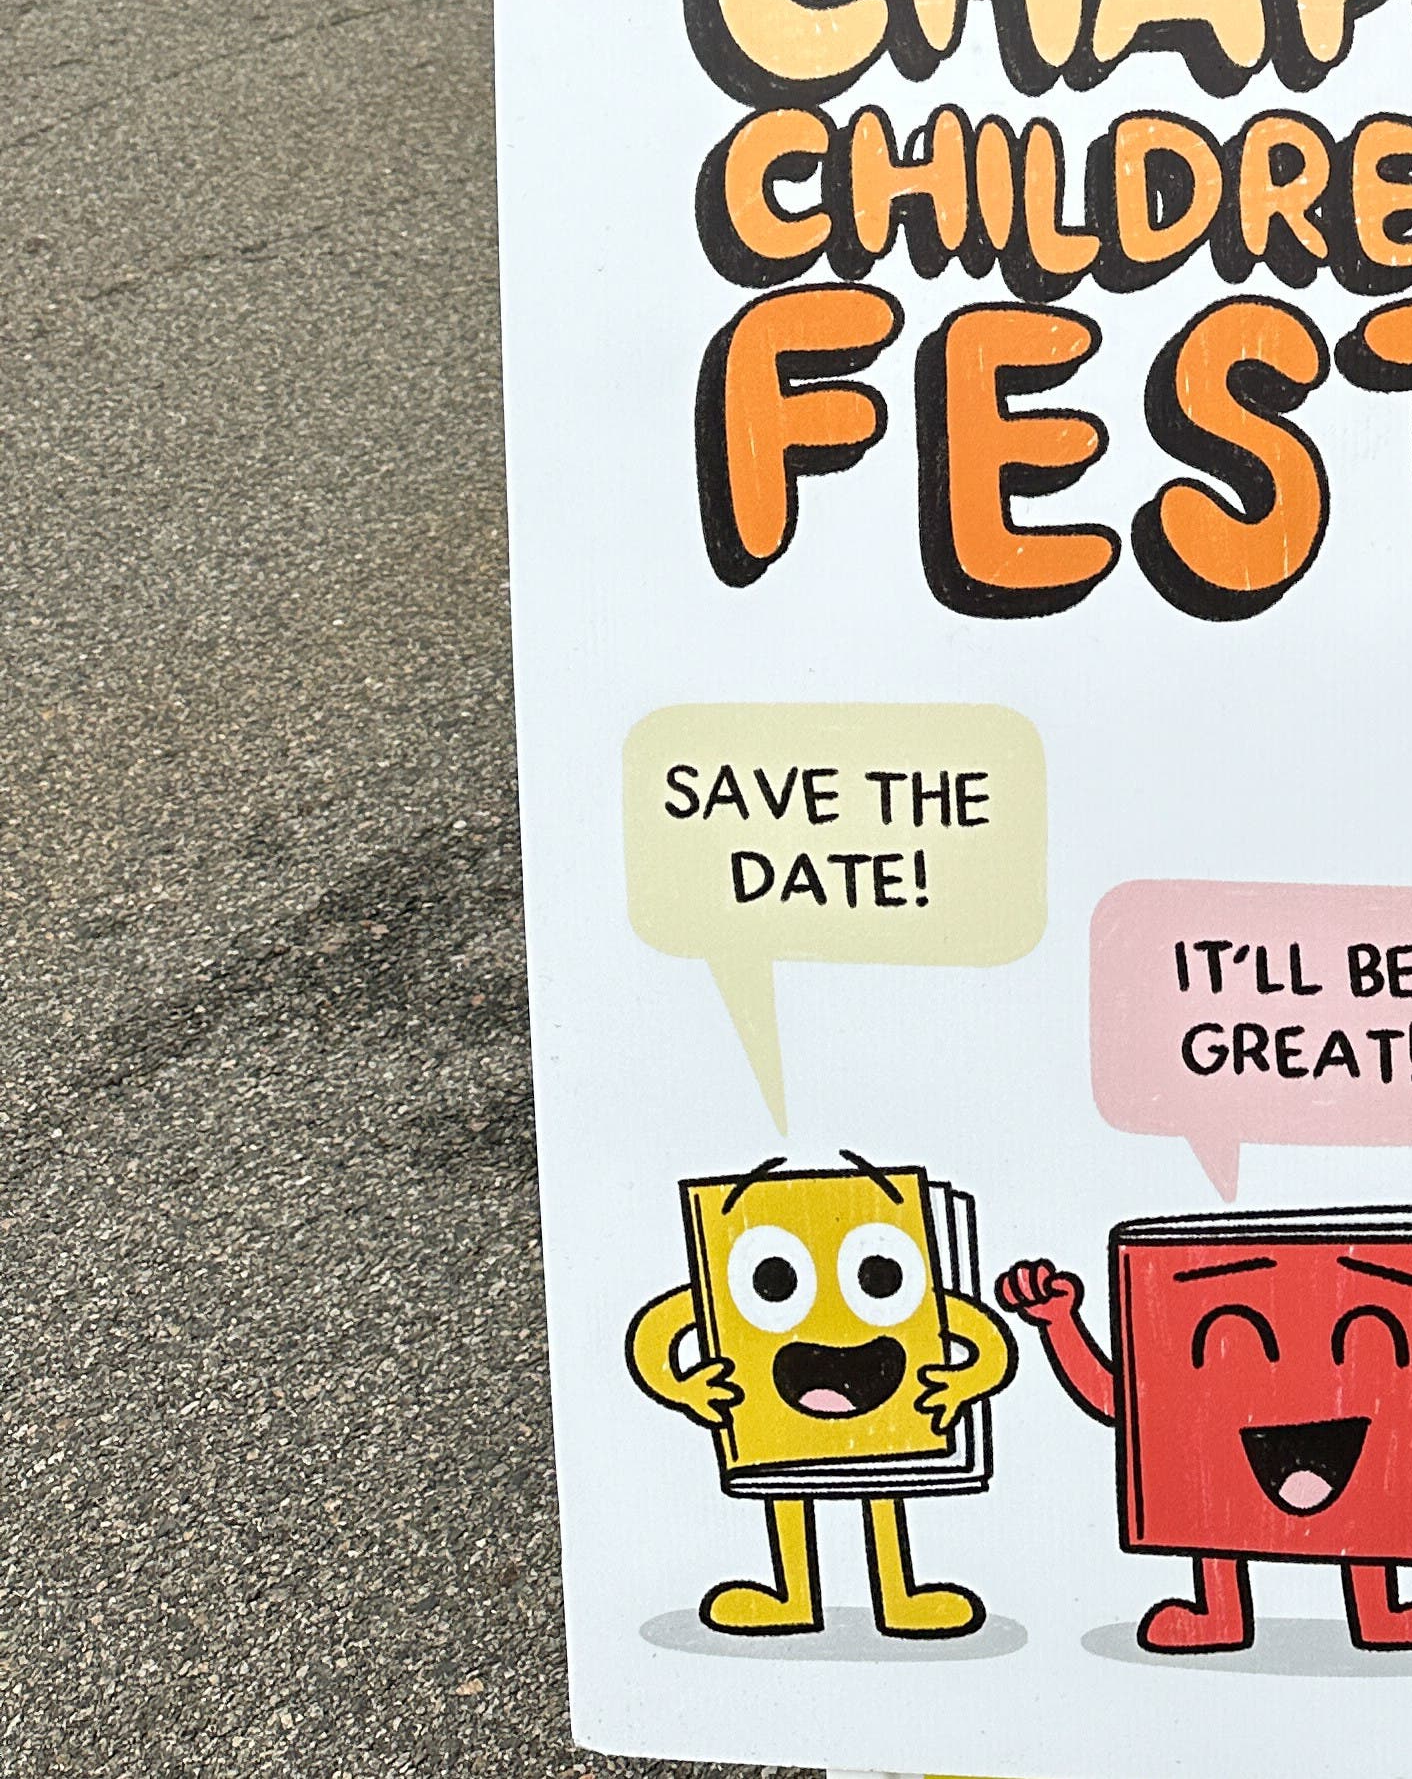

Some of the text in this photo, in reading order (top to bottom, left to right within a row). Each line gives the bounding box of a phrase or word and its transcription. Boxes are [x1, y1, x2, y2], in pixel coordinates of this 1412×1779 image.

[663, 763, 991, 829] SAVE THE
[730, 848, 930, 910] DATE!
[1173, 939, 1324, 997] IT'LL
